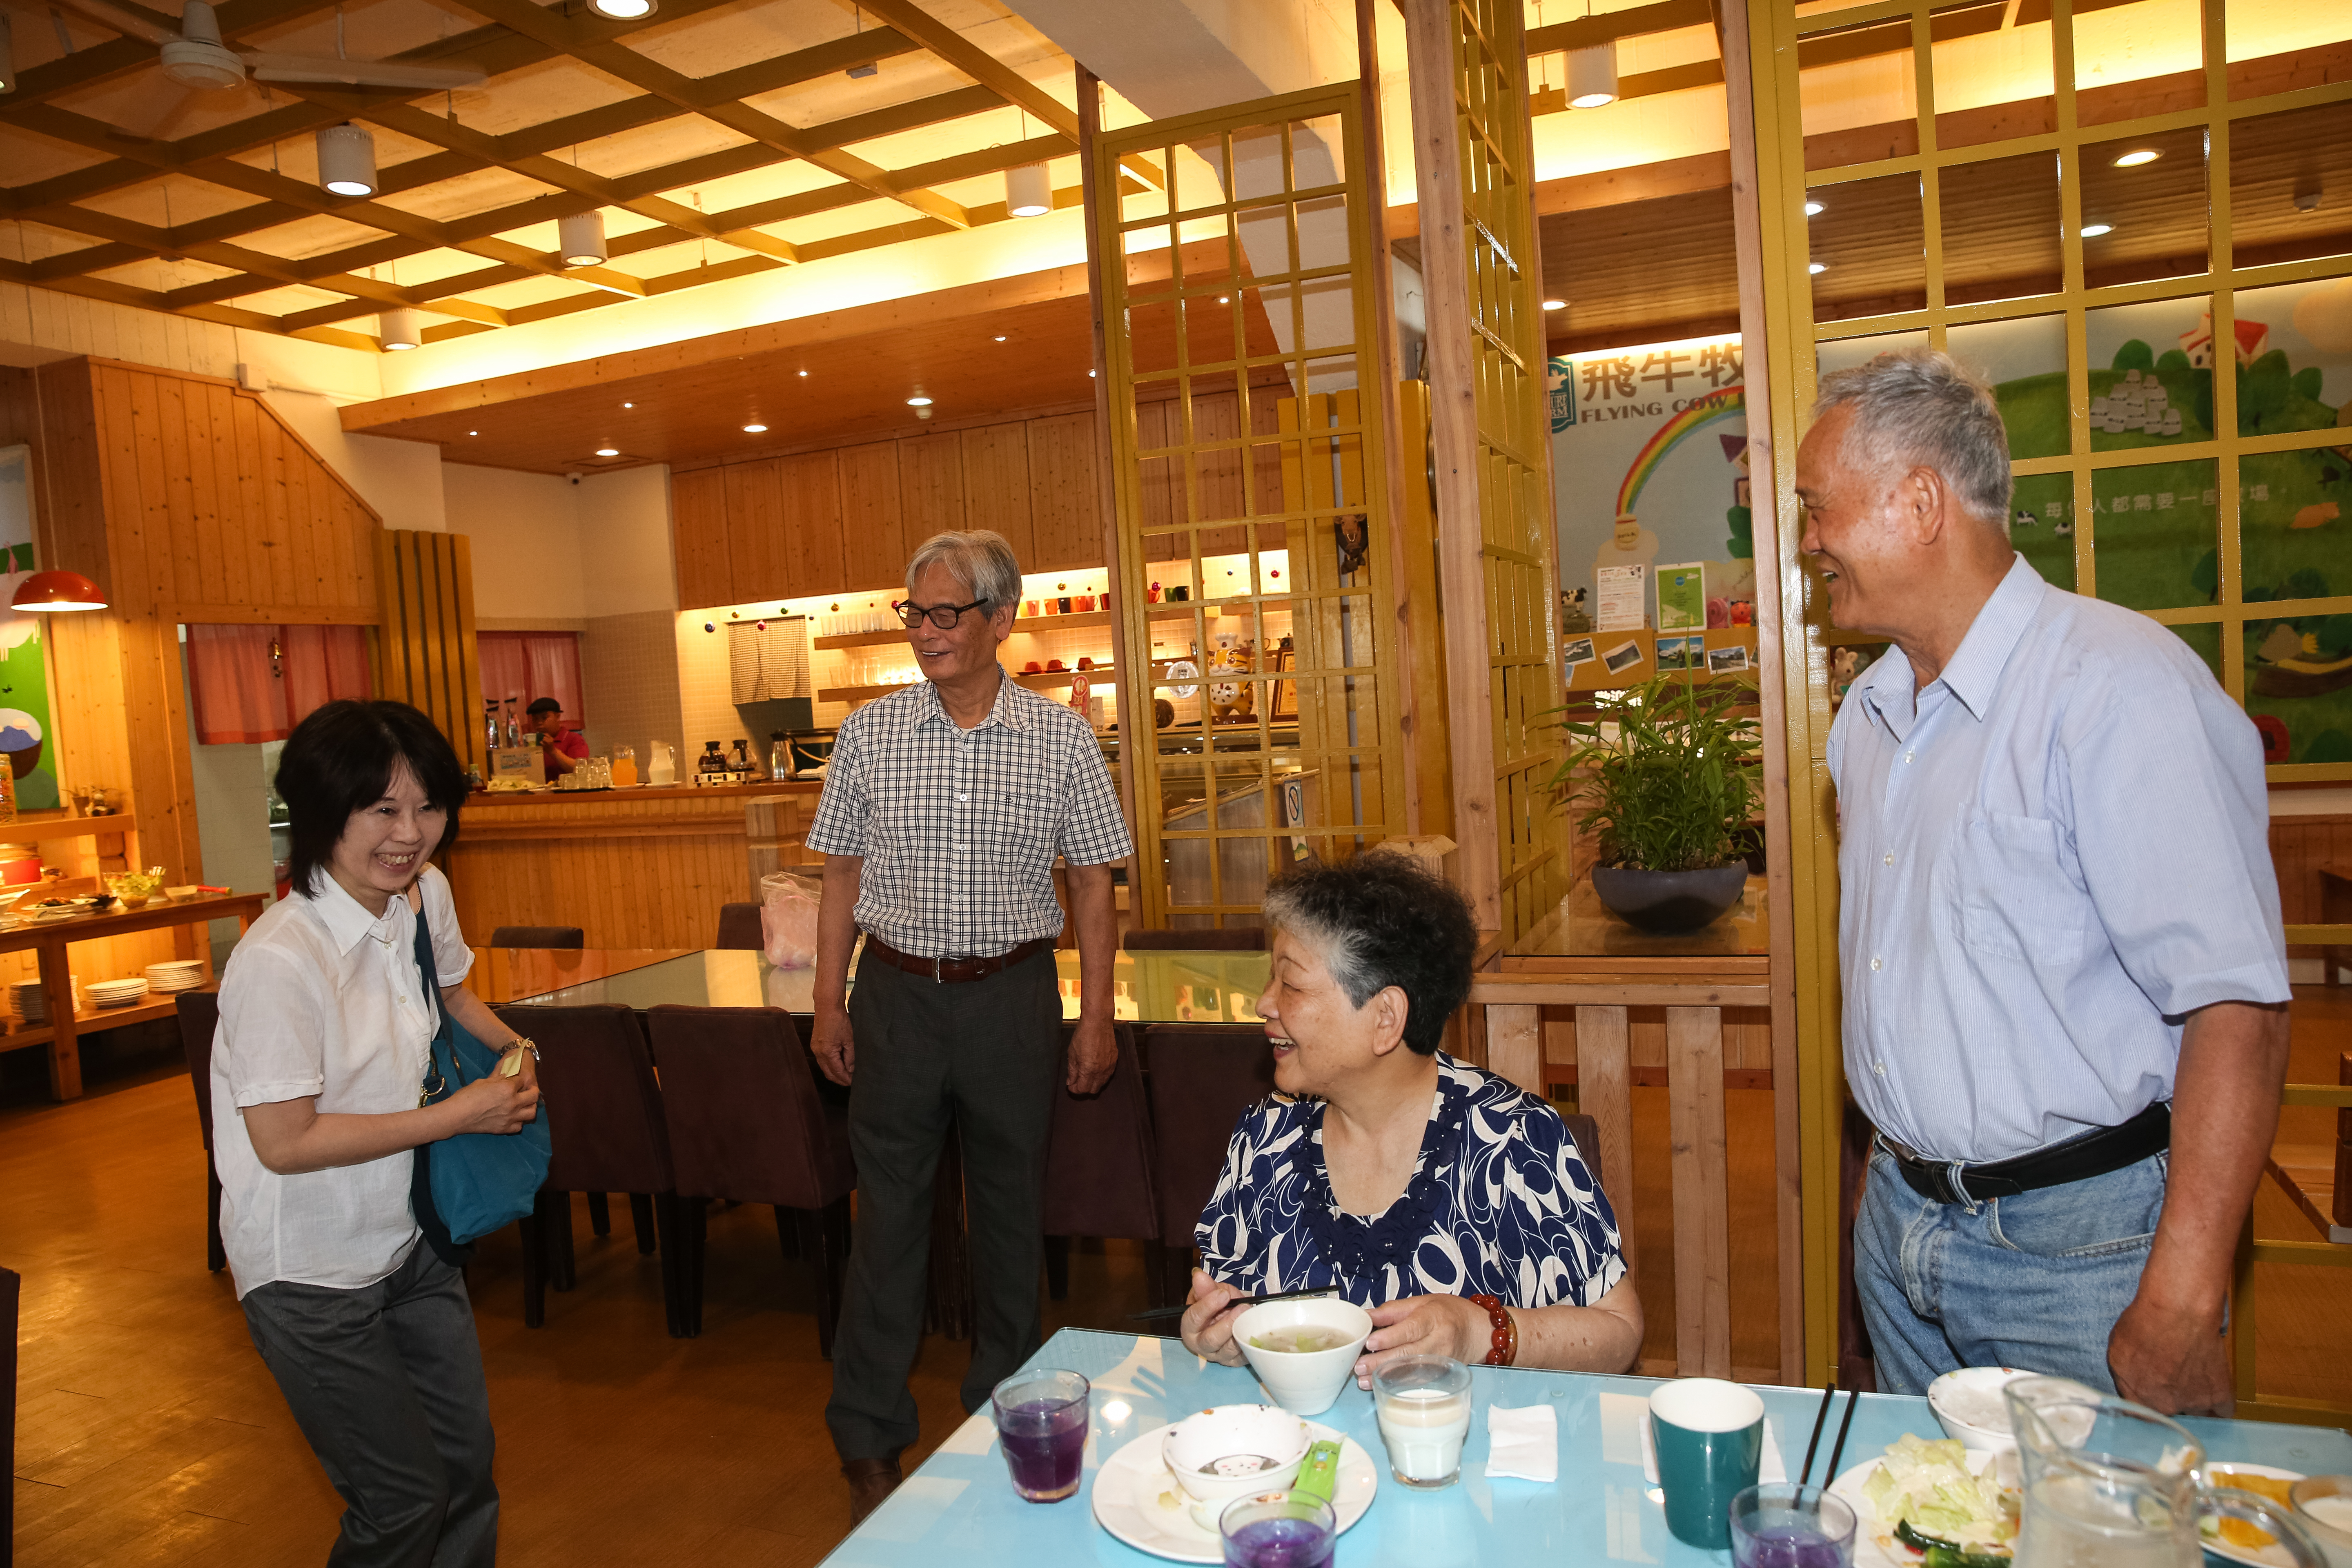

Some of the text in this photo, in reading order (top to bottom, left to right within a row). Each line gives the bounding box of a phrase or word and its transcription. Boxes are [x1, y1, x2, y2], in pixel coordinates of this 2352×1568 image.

[1581, 342, 1744, 402] 飛牛牧
[1581, 401, 1663, 423] FLYING
[1671, 395, 1728, 413] COW
